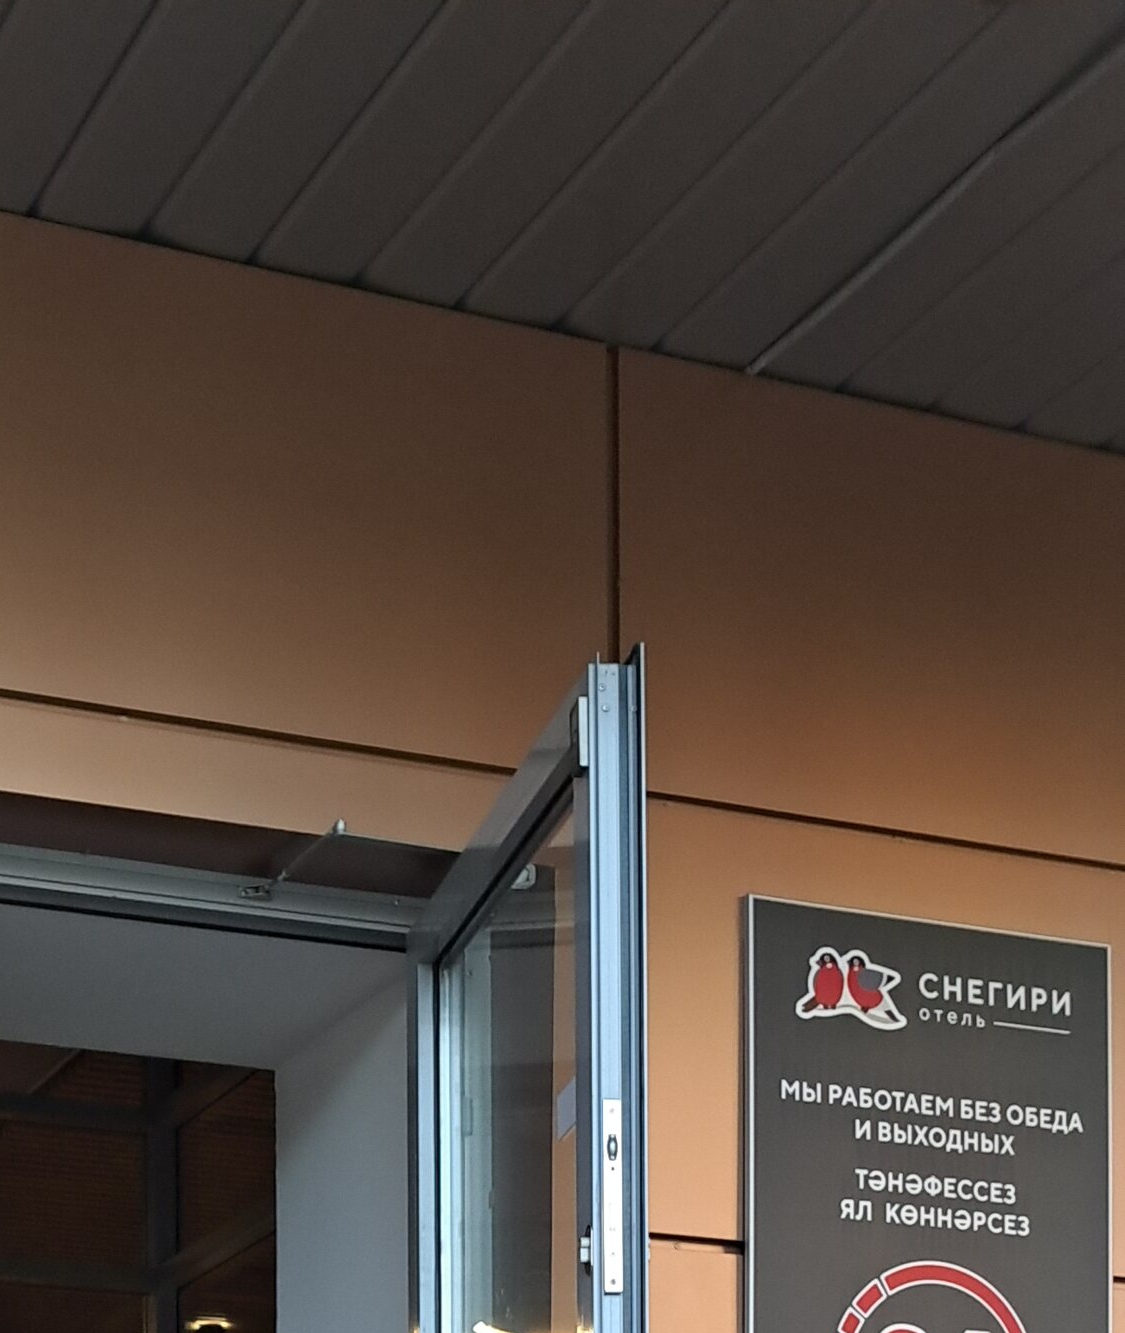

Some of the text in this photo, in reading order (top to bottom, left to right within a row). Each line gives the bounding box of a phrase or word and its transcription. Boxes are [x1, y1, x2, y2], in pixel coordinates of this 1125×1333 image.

[918, 972, 1072, 1017] СНЕГИРИ
[918, 1007, 986, 1028] отель
[780, 1079, 1084, 1134] МЫ РАБОТАЕМ БЕЗ ОБЕДА
[854, 1119, 1016, 1156] И ВЫХОДНЫХ
[854, 1168, 1017, 1205] ТӘНӘФЕССЕЗ
[840, 1199, 1030, 1237] ЯЛ КӨННӘРСЕЗ
